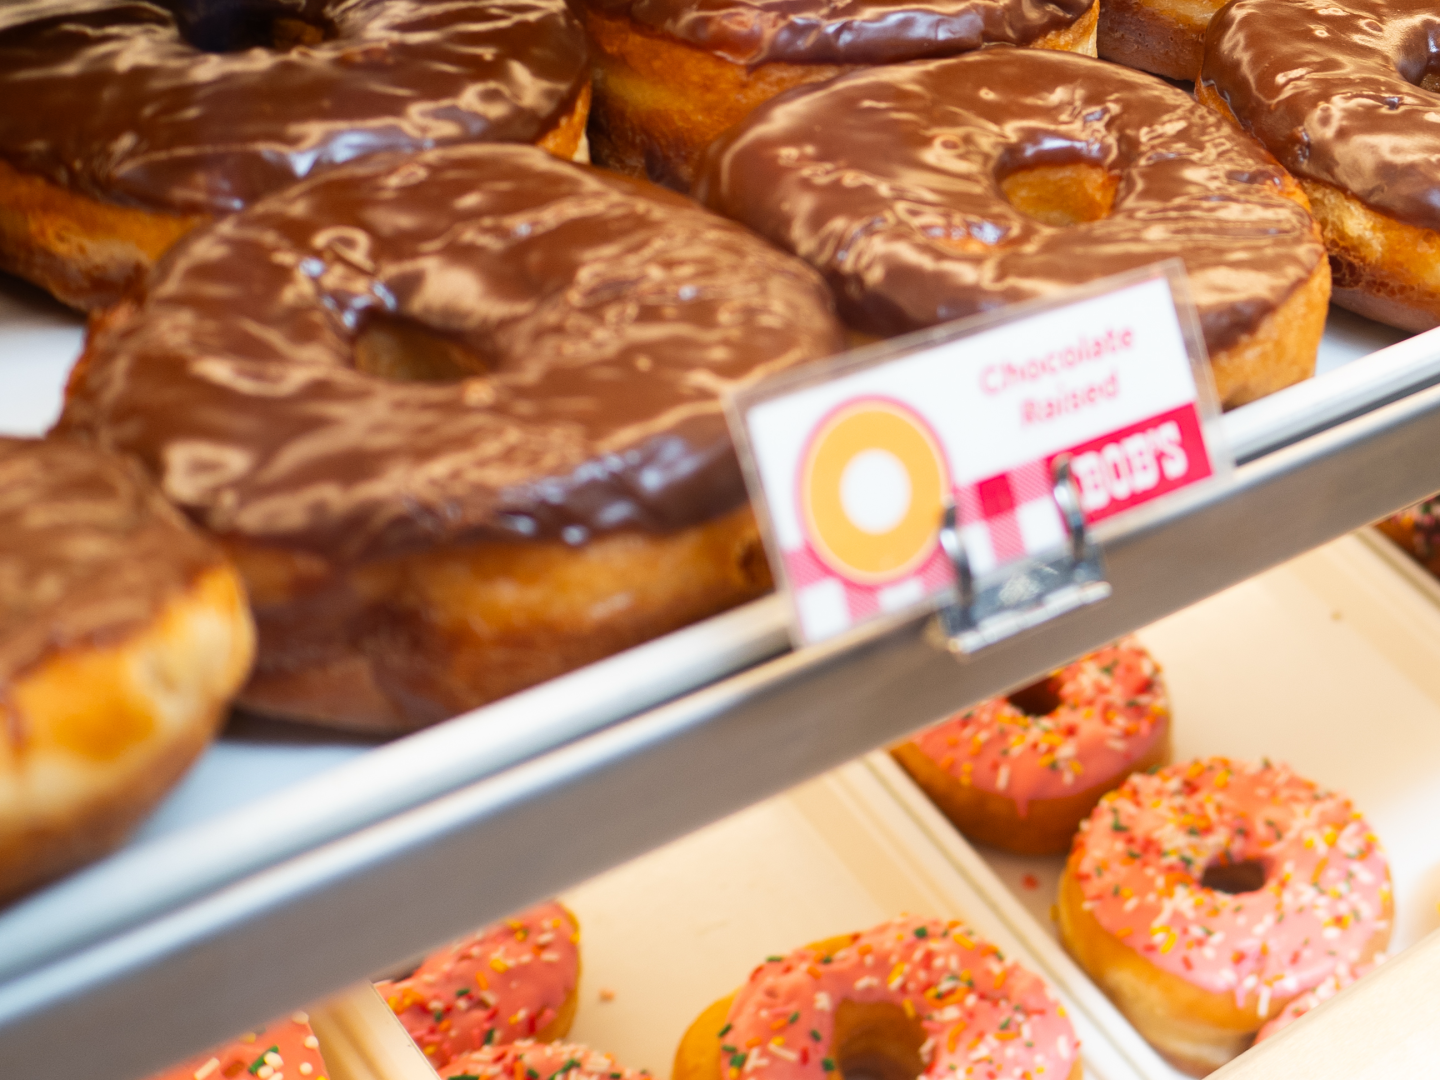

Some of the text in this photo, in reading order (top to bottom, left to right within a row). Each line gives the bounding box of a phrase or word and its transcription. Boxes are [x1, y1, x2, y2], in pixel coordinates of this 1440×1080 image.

[979, 327, 1133, 395] Chocolate
[1021, 369, 1120, 426] Raised
[1070, 420, 1189, 512] BOB'S
